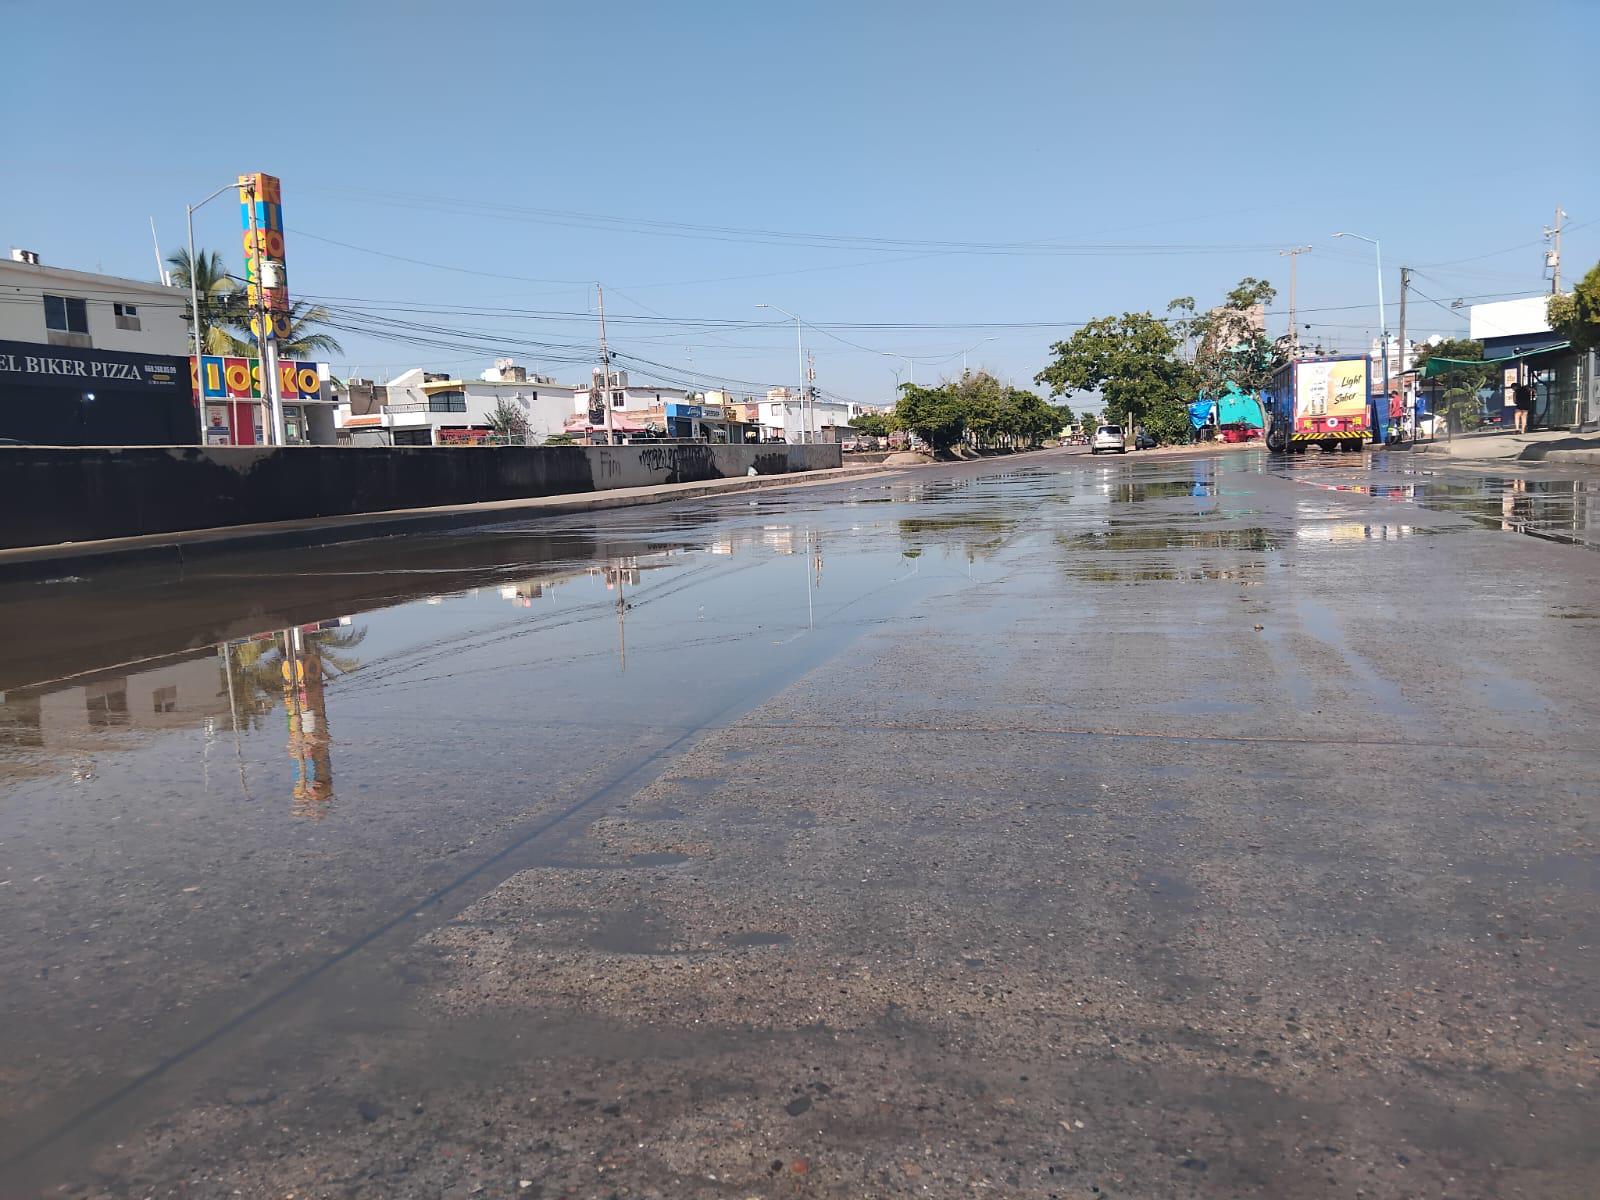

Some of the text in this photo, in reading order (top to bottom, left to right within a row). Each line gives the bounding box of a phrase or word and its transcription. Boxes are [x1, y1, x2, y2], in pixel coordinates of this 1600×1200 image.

[0, 354, 21, 372] EL
[24, 356, 88, 377] BIKER
[91, 361, 143, 380] PIZZA
[1341, 374, 1362, 388] Light
